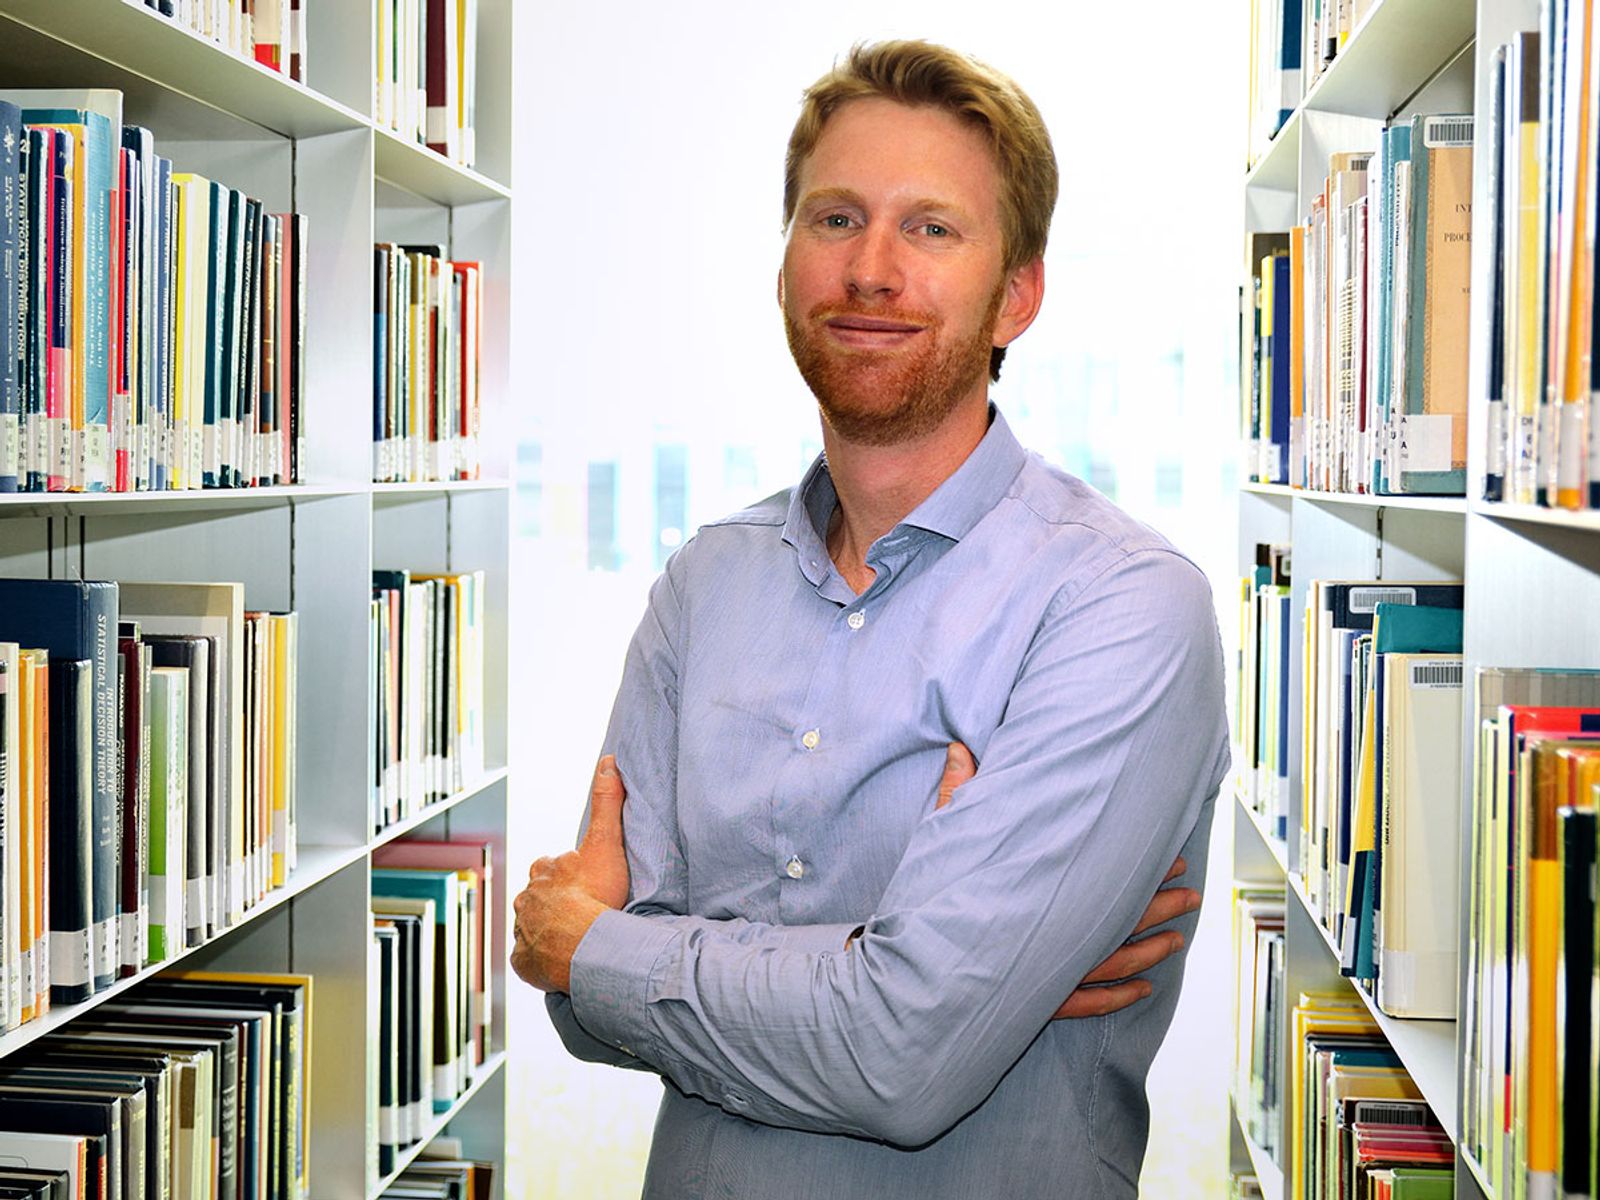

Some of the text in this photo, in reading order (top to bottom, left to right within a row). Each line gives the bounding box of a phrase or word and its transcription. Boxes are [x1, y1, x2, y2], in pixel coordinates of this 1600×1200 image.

[17, 173, 27, 360] STATISTICAL DISTRIBUTIONS
[90, 275, 95, 289] of
[96, 356, 103, 368] in
[98, 613, 107, 795] STATISTICAL DECISION THEORY
[106, 687, 115, 793] INTRODUCTION TO
